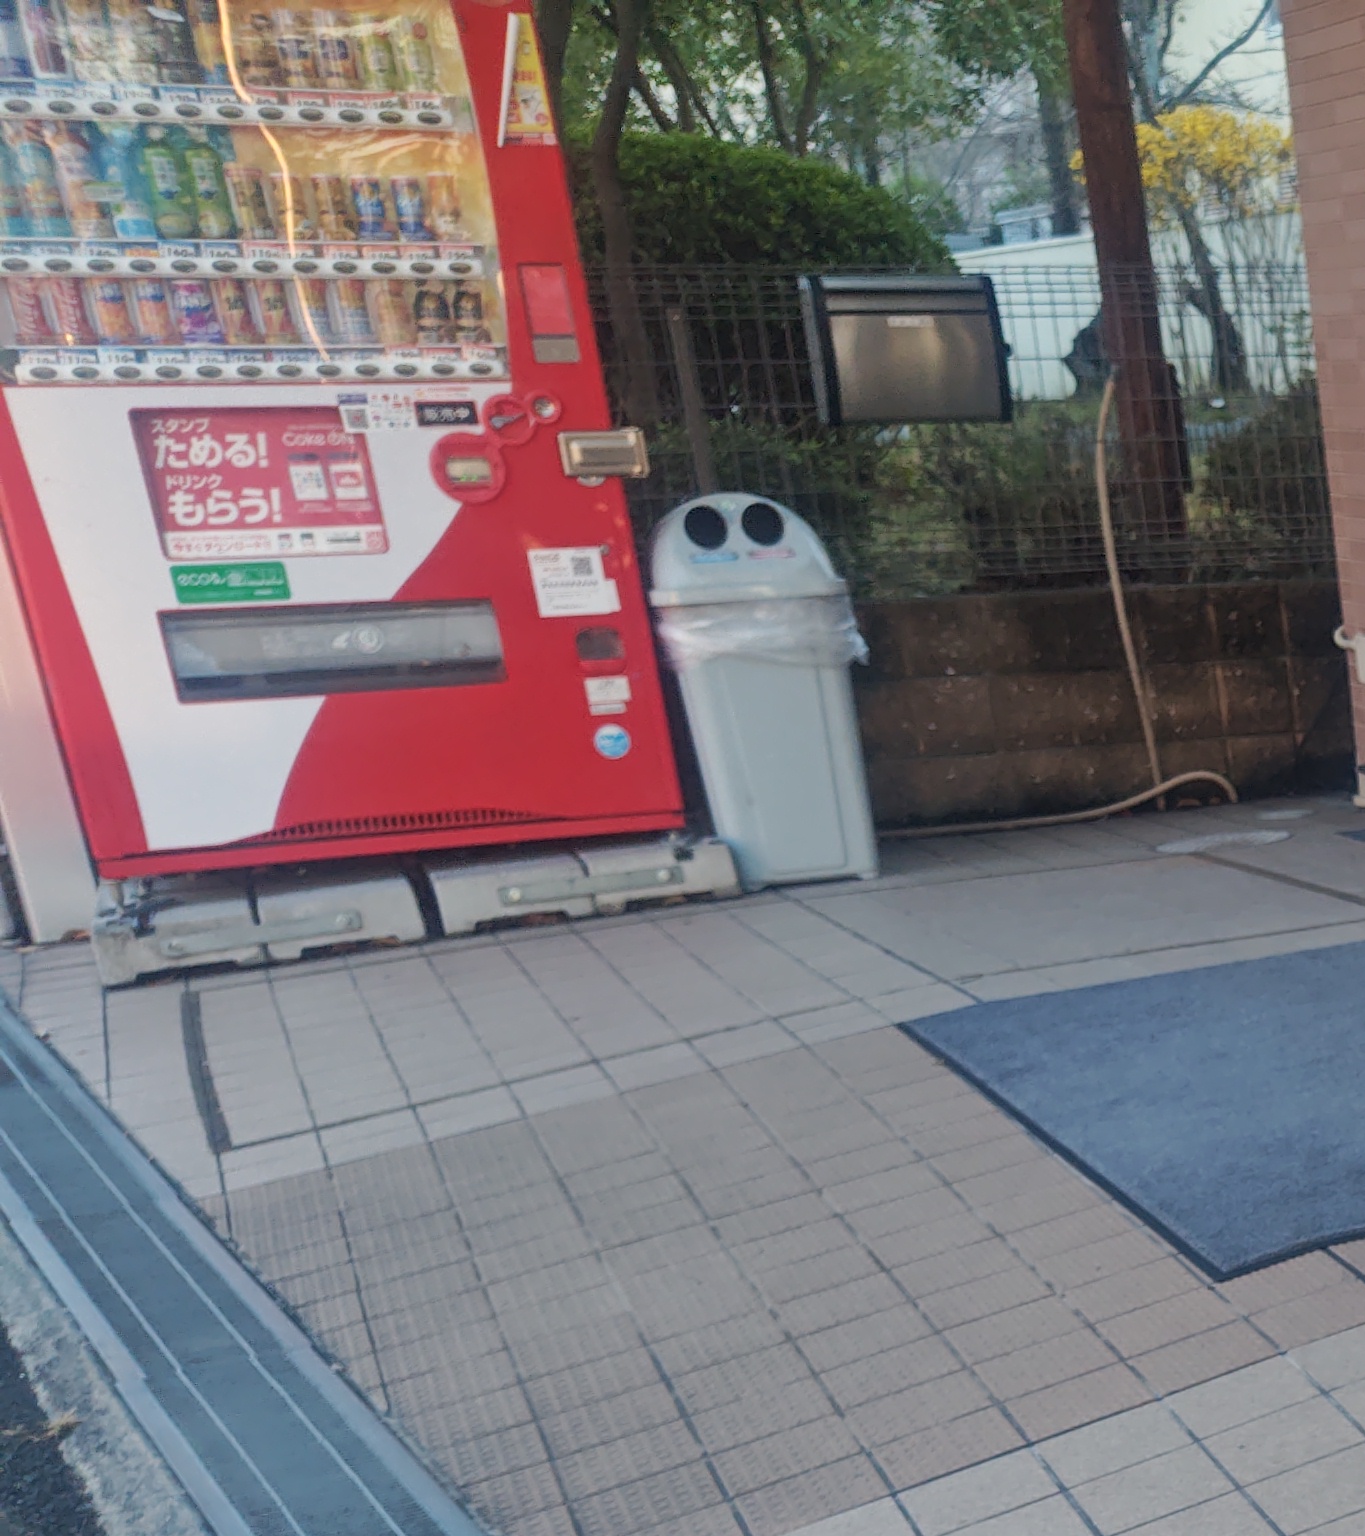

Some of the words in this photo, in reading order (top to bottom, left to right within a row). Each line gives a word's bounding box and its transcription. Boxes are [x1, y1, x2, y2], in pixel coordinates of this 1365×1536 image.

[150, 417, 211, 434] スタンプ
[281, 431, 326, 447] Coke
[165, 473, 223, 490] ドリンク
